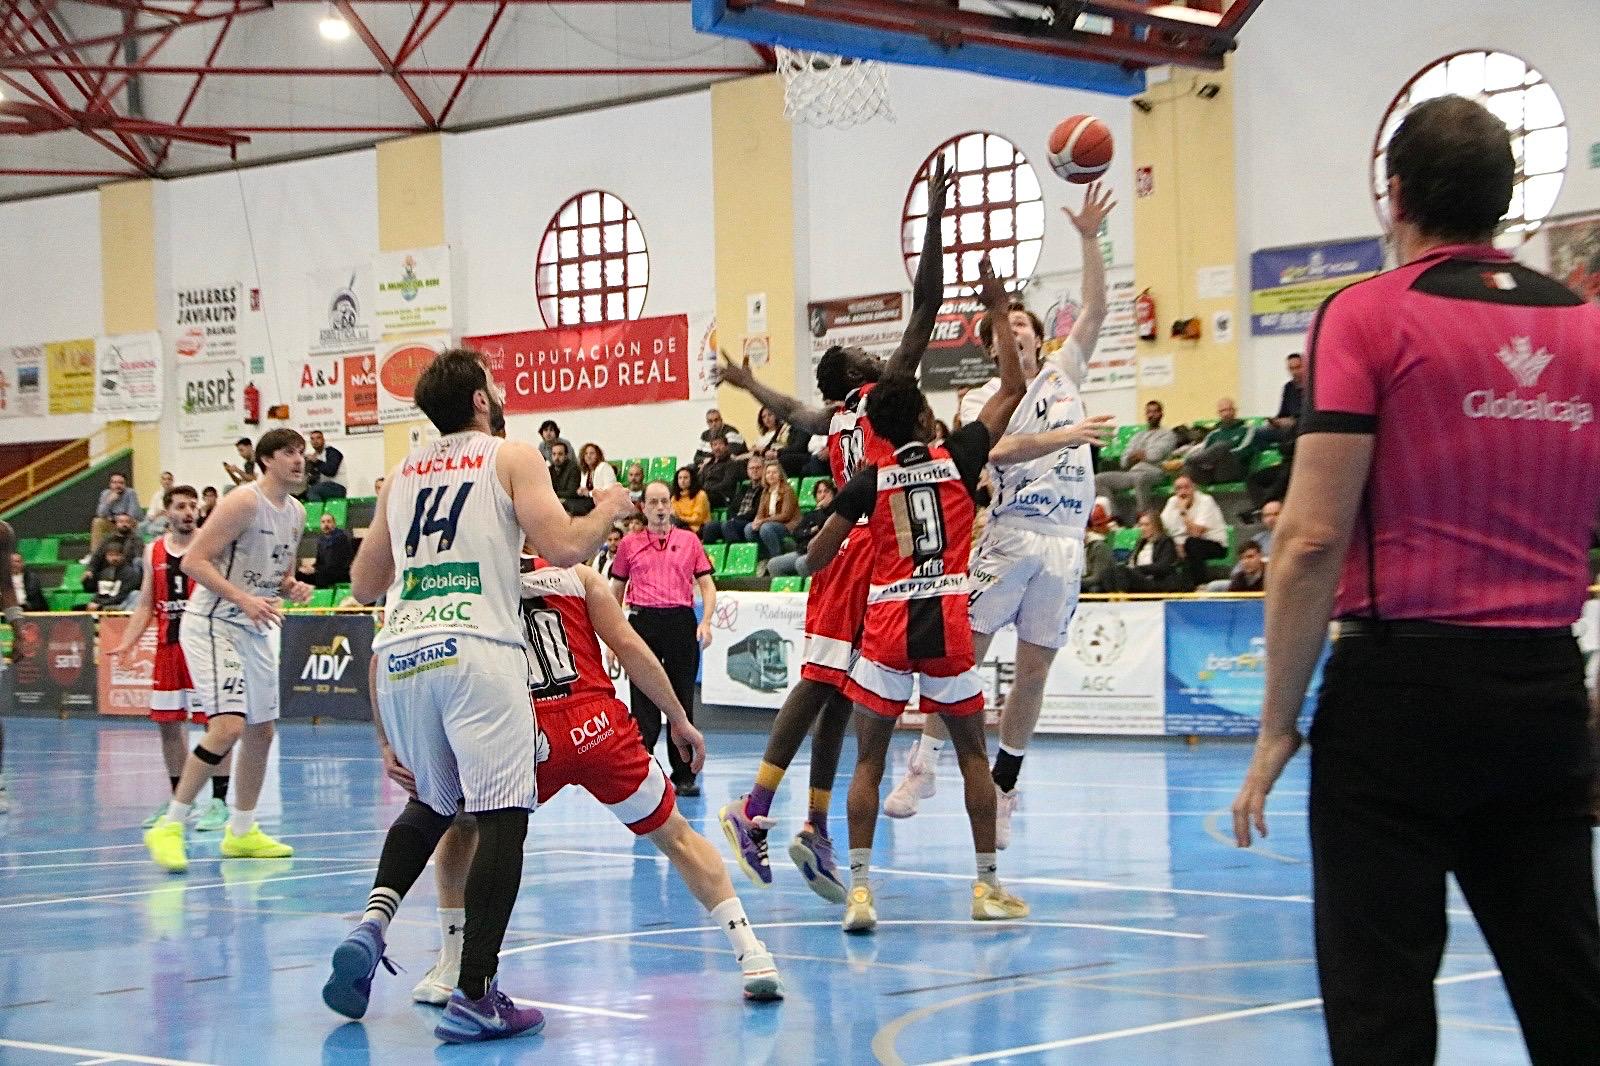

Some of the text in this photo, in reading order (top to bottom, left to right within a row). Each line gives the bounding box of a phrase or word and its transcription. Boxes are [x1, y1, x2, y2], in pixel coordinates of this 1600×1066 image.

[177, 287, 236, 308] TALLERES
[176, 305, 236, 326] JAVIAUTO
[653, 335, 677, 355] DE
[301, 361, 338, 388] A & J
[514, 357, 677, 396] CIUDAD REAL
[405, 481, 475, 558] 14
[908, 486, 943, 555] 9
[420, 601, 473, 623] AGC
[301, 654, 353, 681] ADV
[1081, 675, 1115, 692] AGC
[569, 711, 610, 747] DCM
[577, 727, 615, 755] consultores
